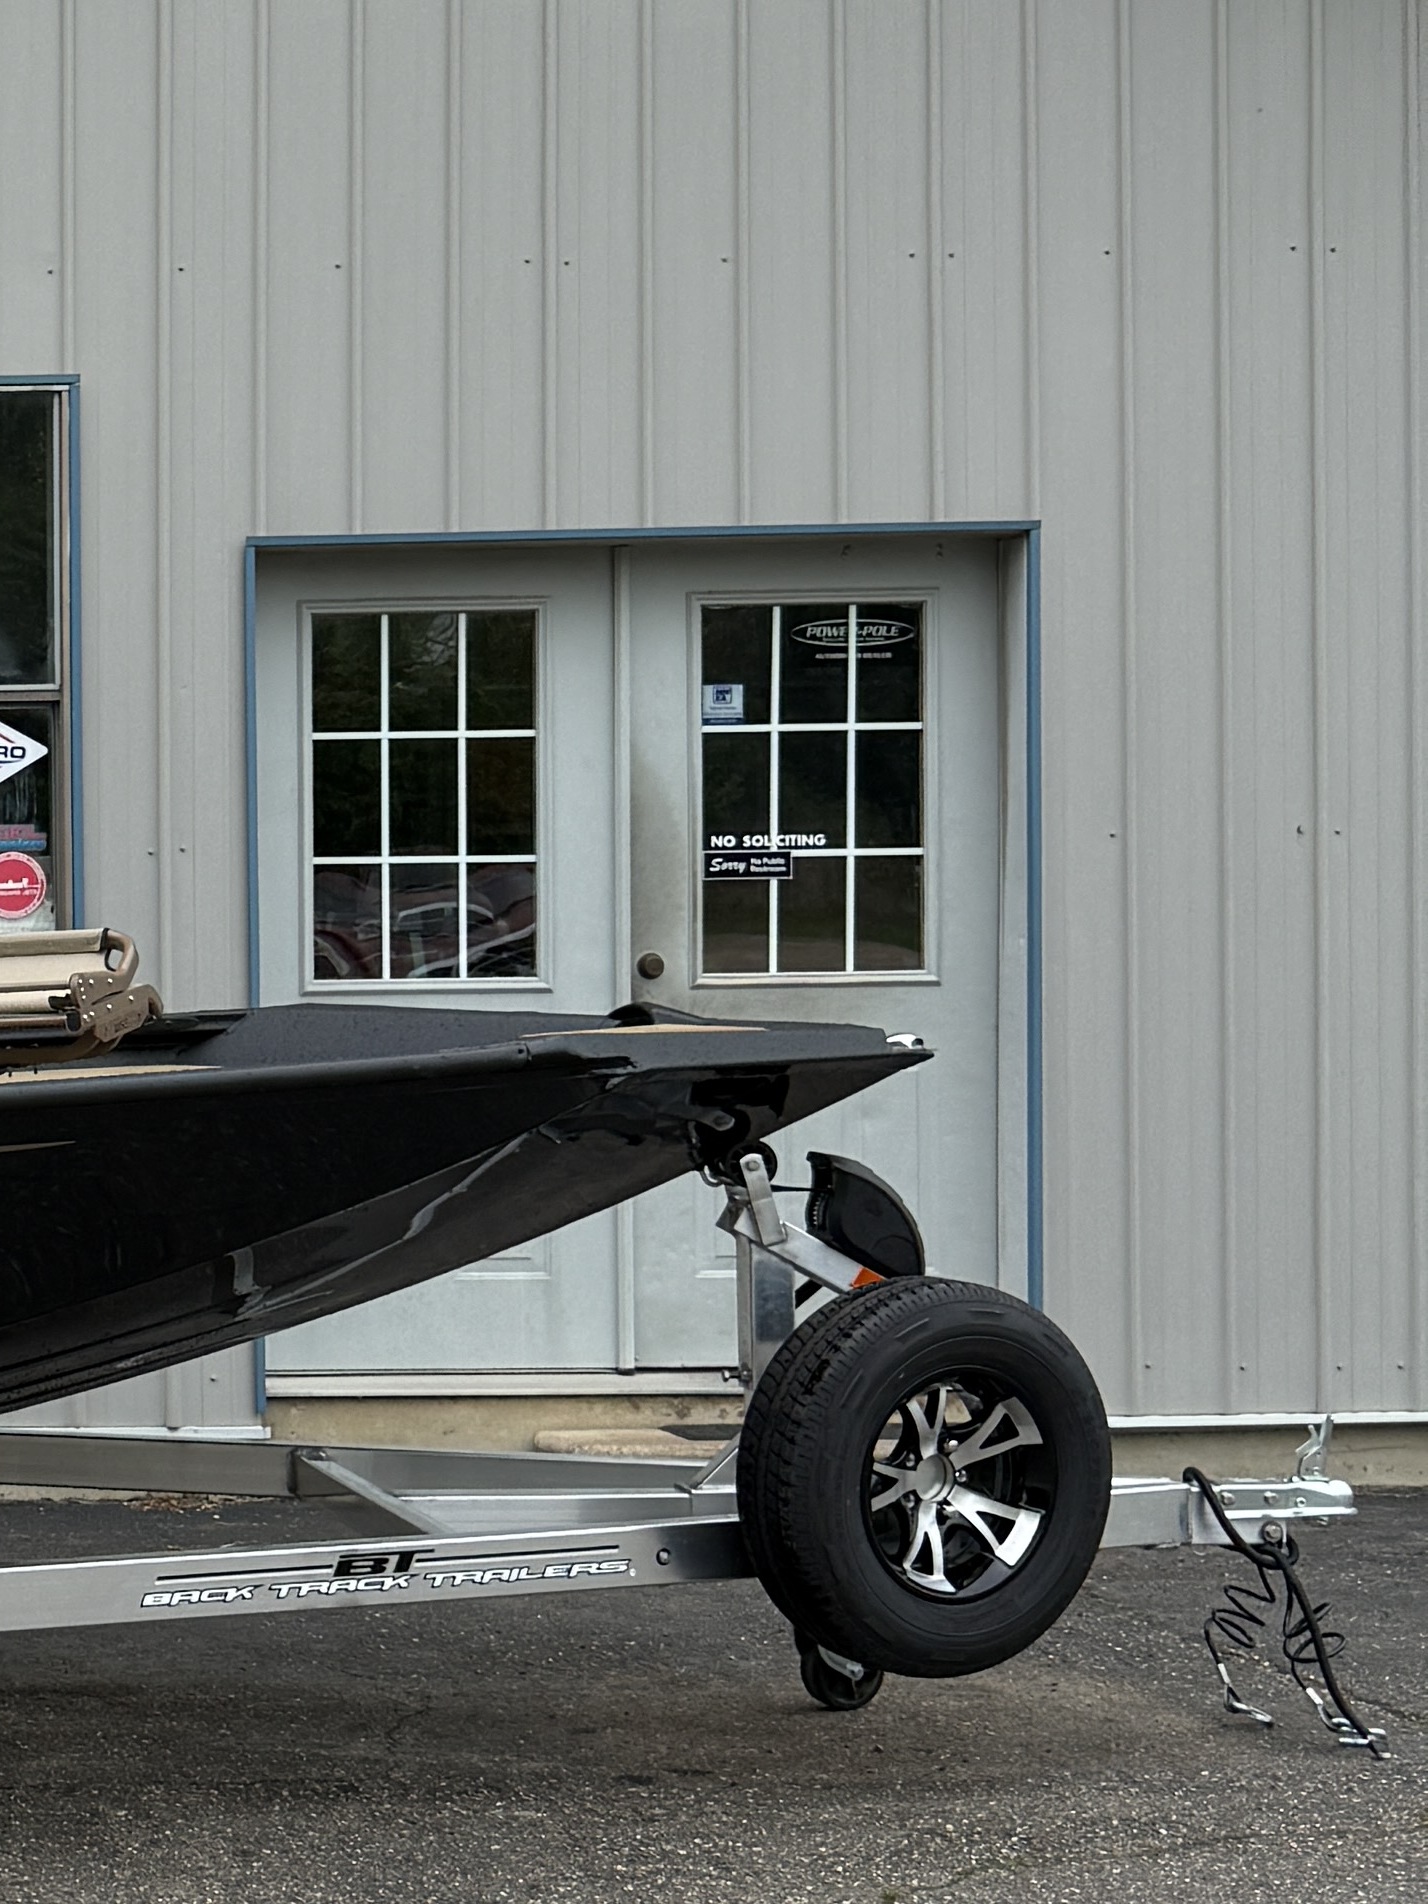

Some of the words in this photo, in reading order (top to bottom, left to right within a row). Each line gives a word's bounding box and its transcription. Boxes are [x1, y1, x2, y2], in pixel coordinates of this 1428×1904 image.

[806, 625, 900, 638] POWE-POLE
[710, 835, 736, 848] NO
[709, 857, 746, 874] Sorry
[333, 1549, 435, 1578] BT
[141, 1584, 263, 1608] BACK
[269, 1572, 420, 1600] TRACK
[424, 1559, 632, 1588] TRAILERS
